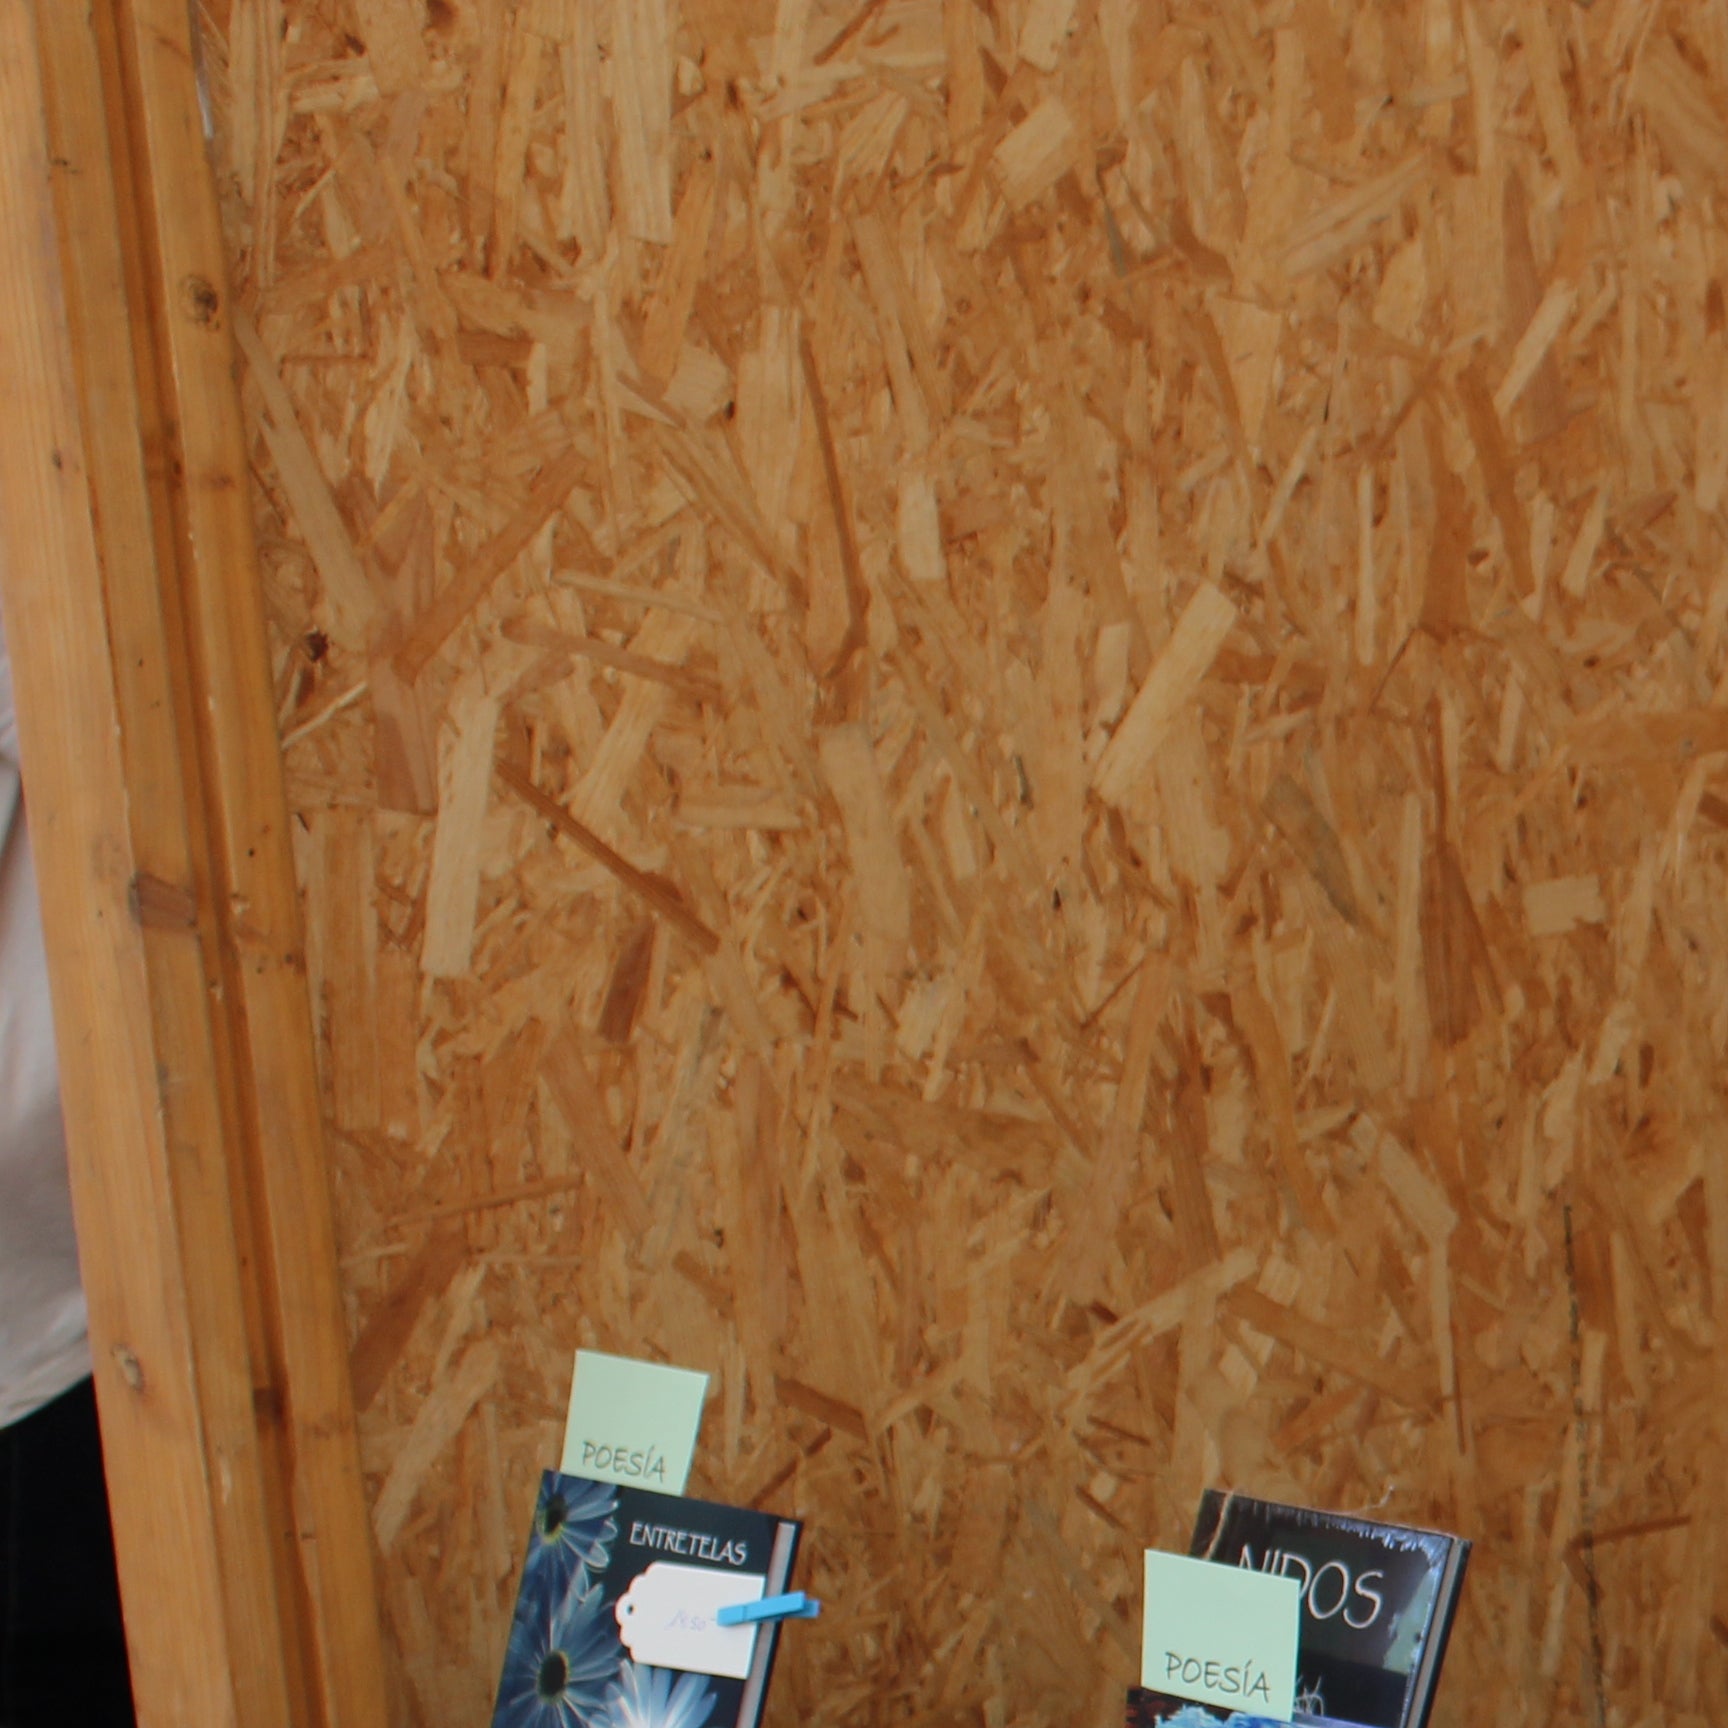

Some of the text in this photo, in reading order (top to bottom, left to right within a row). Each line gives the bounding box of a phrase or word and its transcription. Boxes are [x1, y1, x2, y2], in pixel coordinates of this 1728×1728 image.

[581, 1440, 666, 1484] POESÍA
[629, 1520, 748, 1567] ENTRETELAS
[1163, 1649, 1272, 1704] POESÍA
